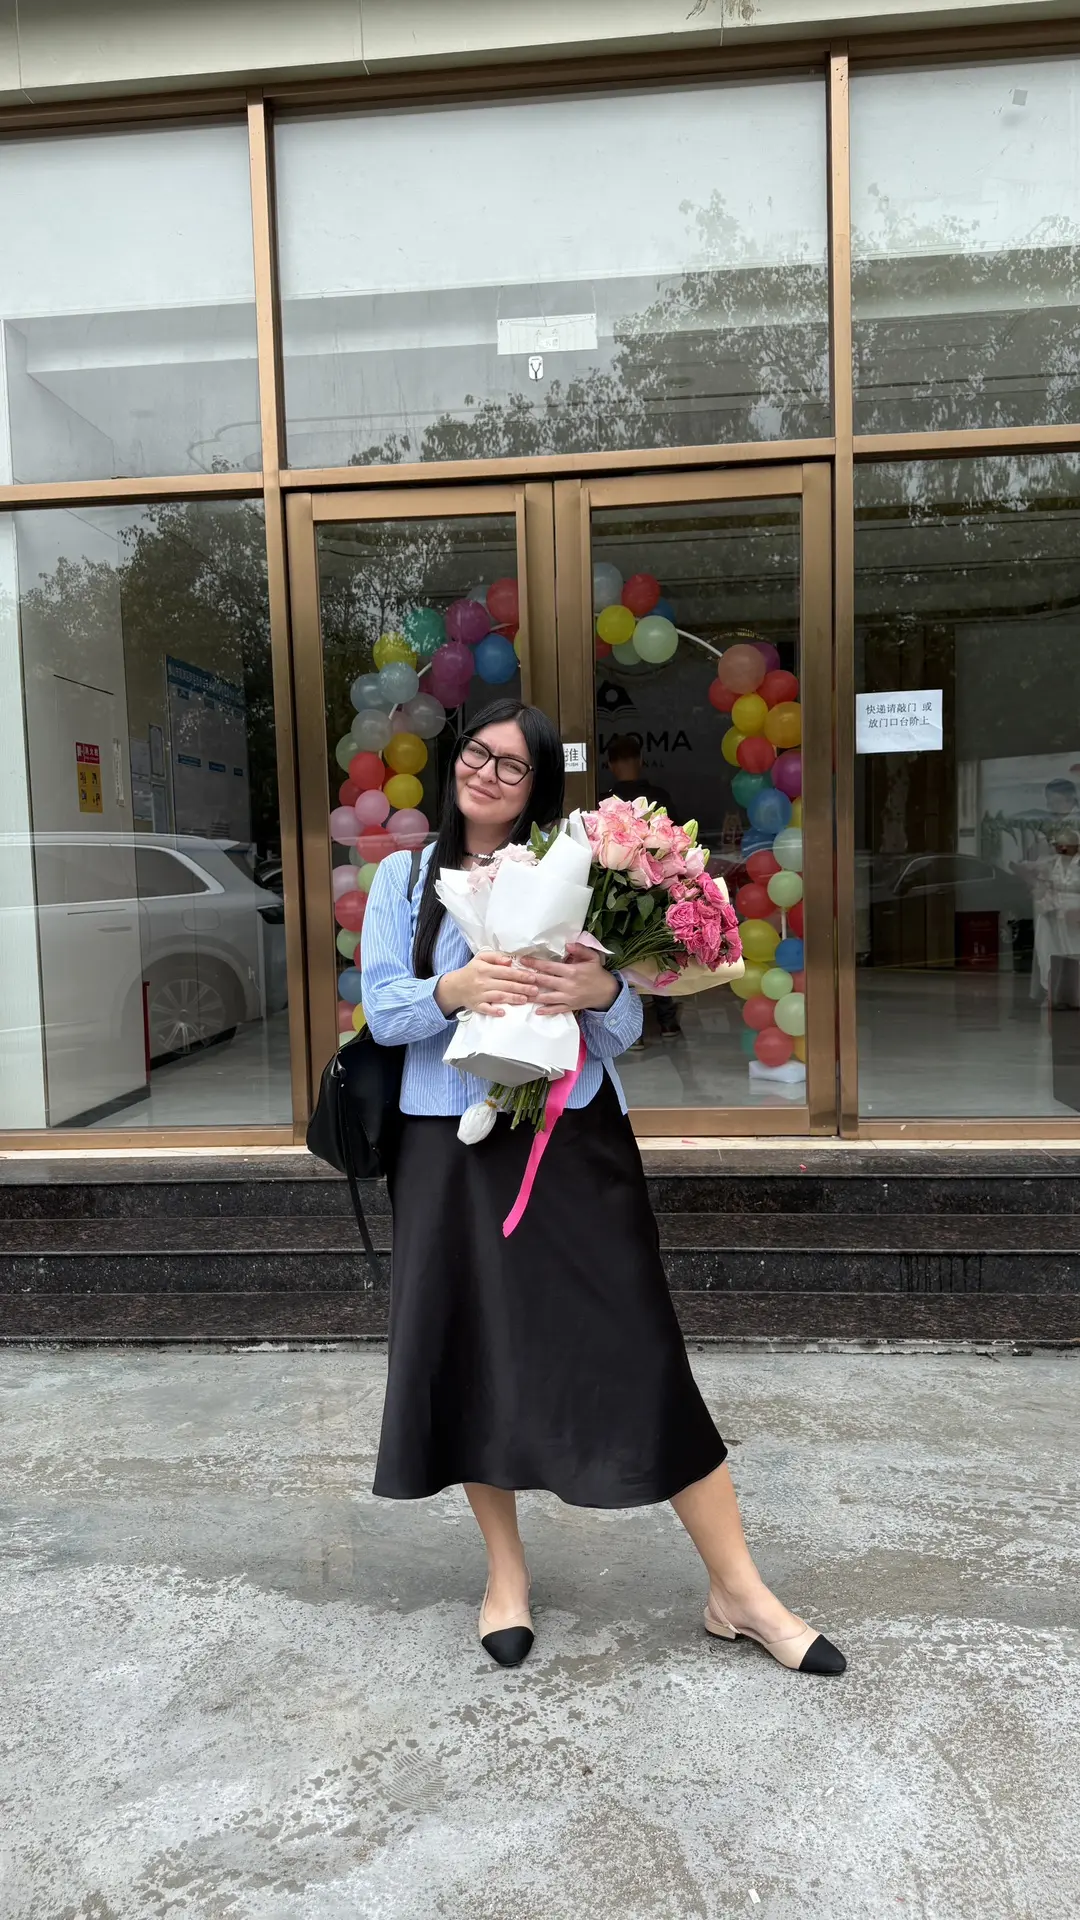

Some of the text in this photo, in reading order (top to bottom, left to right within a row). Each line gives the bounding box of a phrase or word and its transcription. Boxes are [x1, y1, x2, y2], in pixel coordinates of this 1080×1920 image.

[866, 702, 932, 714] 快递请敲门 或
[868, 716, 929, 728] 放门口台阶上
[564, 748, 578, 761] 推
